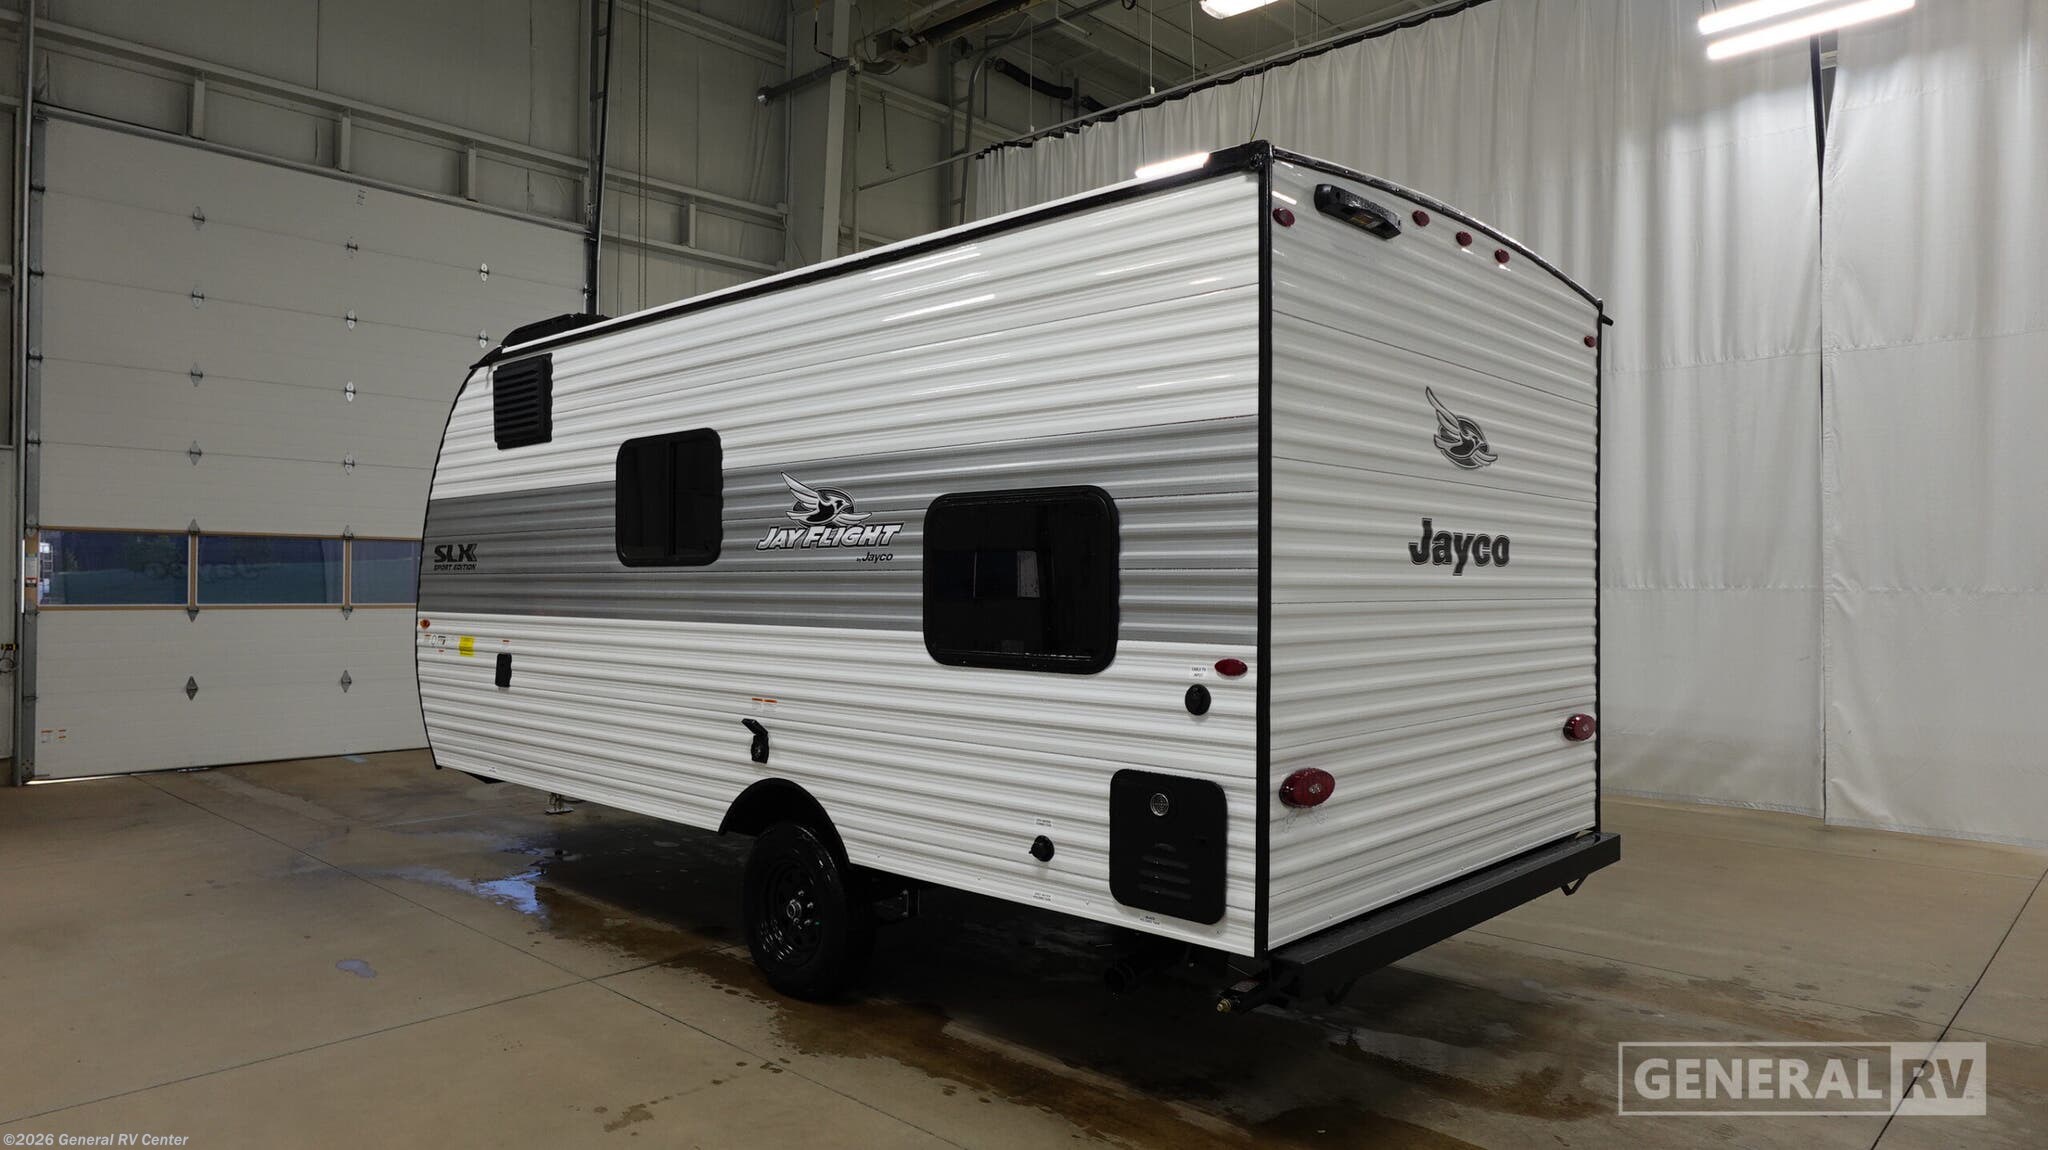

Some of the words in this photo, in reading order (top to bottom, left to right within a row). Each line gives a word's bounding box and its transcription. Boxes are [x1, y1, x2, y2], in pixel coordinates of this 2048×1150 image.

[756, 526, 806, 551] JAY
[802, 522, 904, 549] FLIGHT
[1408, 517, 1511, 576] Jayco
[861, 552, 893, 564] Jayco
